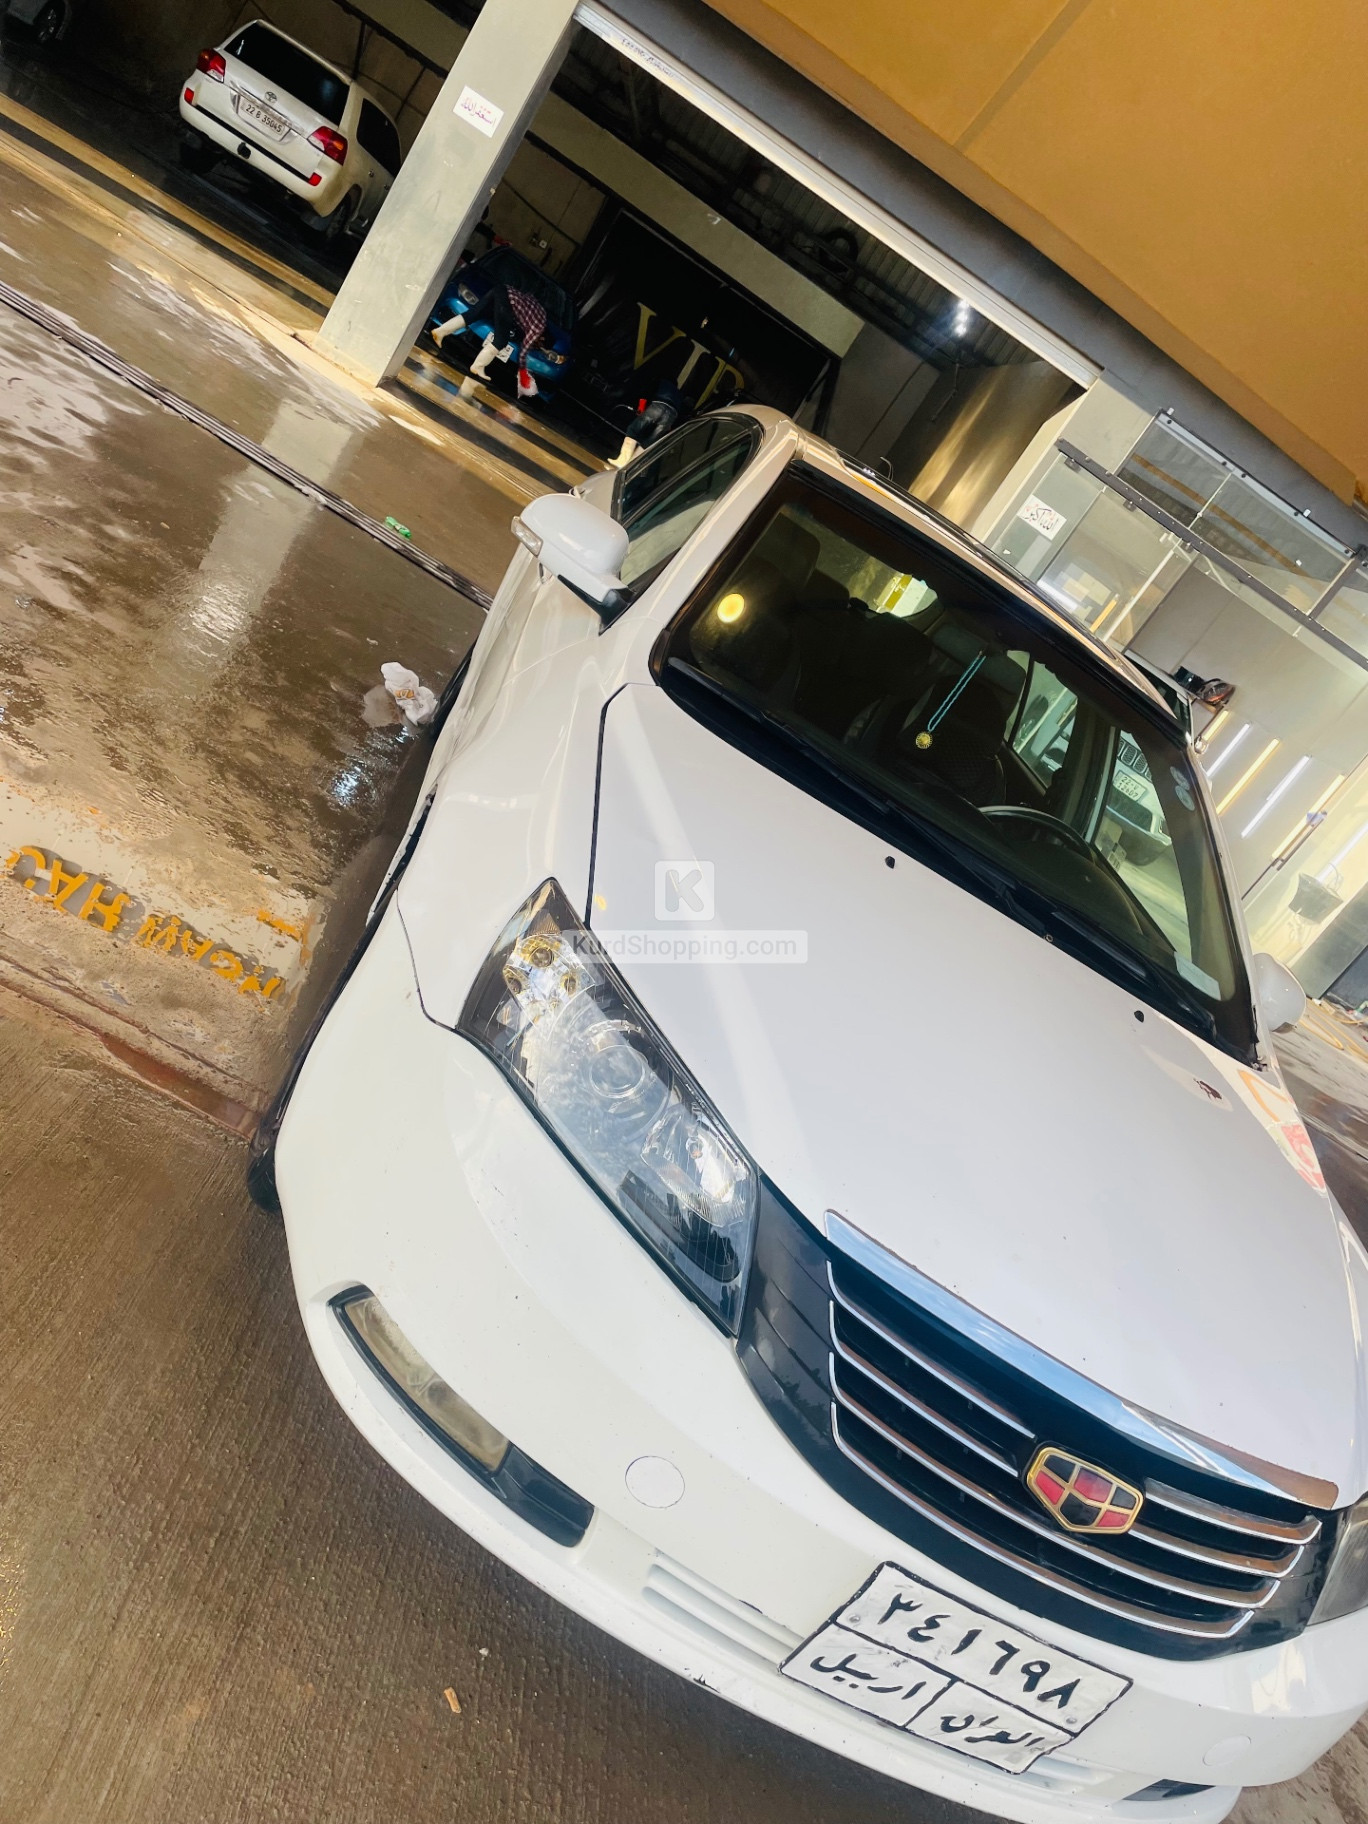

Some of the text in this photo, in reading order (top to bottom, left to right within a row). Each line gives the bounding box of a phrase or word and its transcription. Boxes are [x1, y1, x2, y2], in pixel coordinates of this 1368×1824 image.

[246, 104, 256, 115] 22
[634, 301, 745, 411] VIP
[877, 1592, 1081, 1710] ٣٤١٦٩٨
